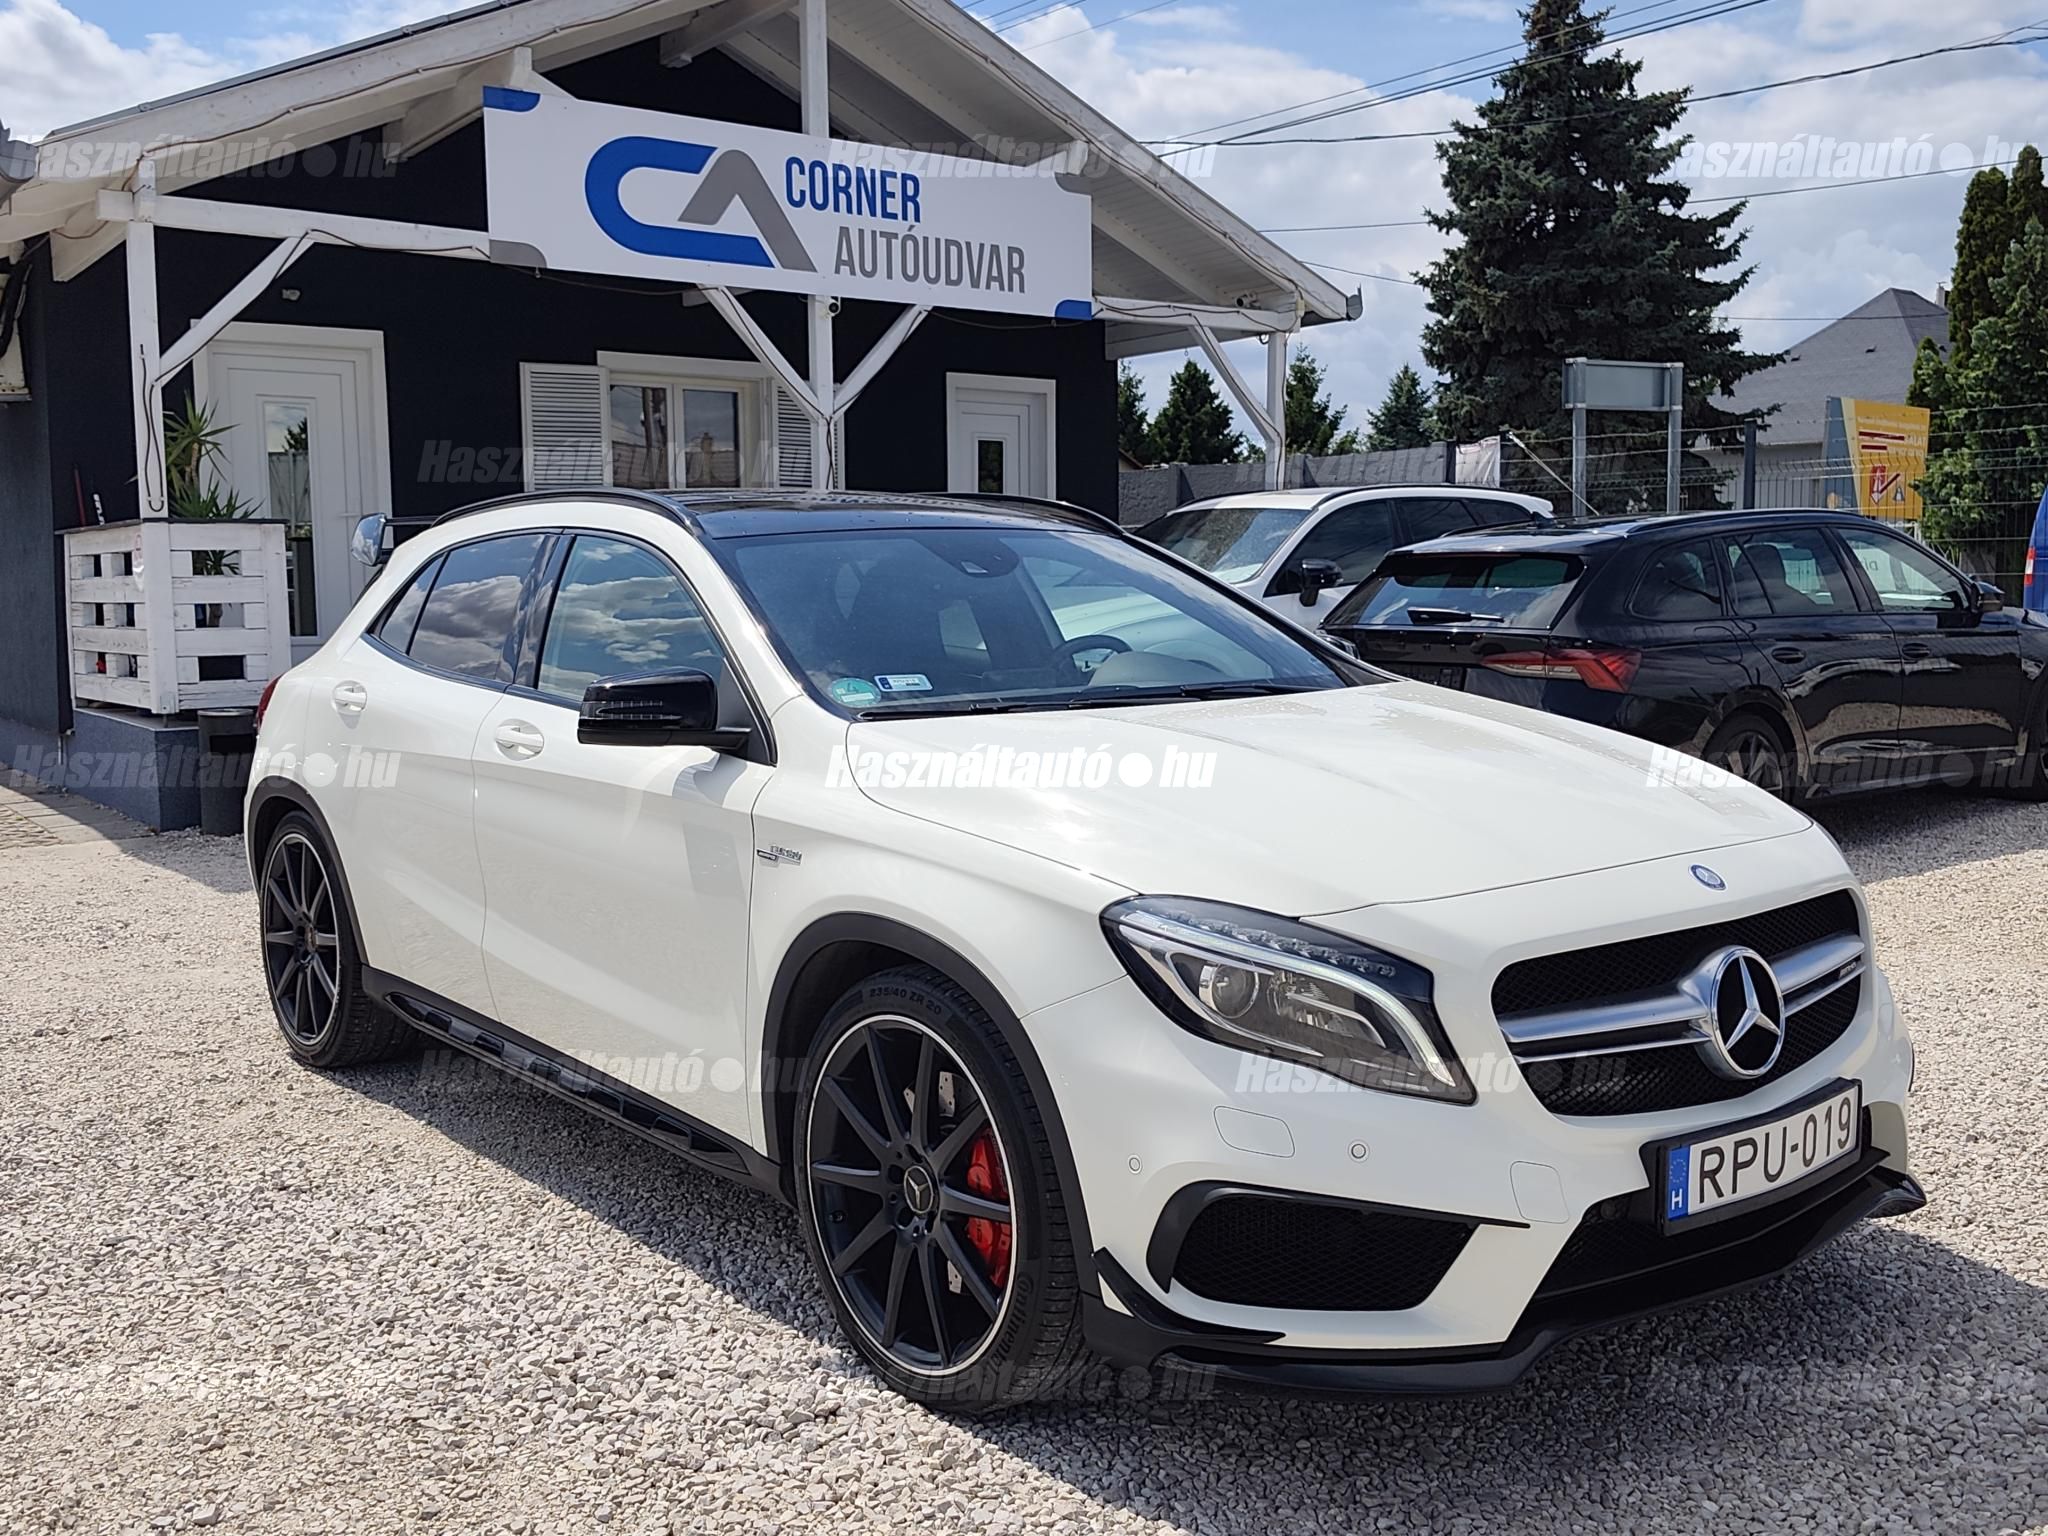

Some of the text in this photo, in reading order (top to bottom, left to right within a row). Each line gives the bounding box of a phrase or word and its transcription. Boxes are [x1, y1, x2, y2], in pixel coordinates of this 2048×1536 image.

[785, 156, 921, 223] CORNER
[834, 225, 1025, 293] AUTÓUDVAR
[1699, 1096, 1851, 1204] RPU-019
[1671, 1188, 1682, 1211] H
